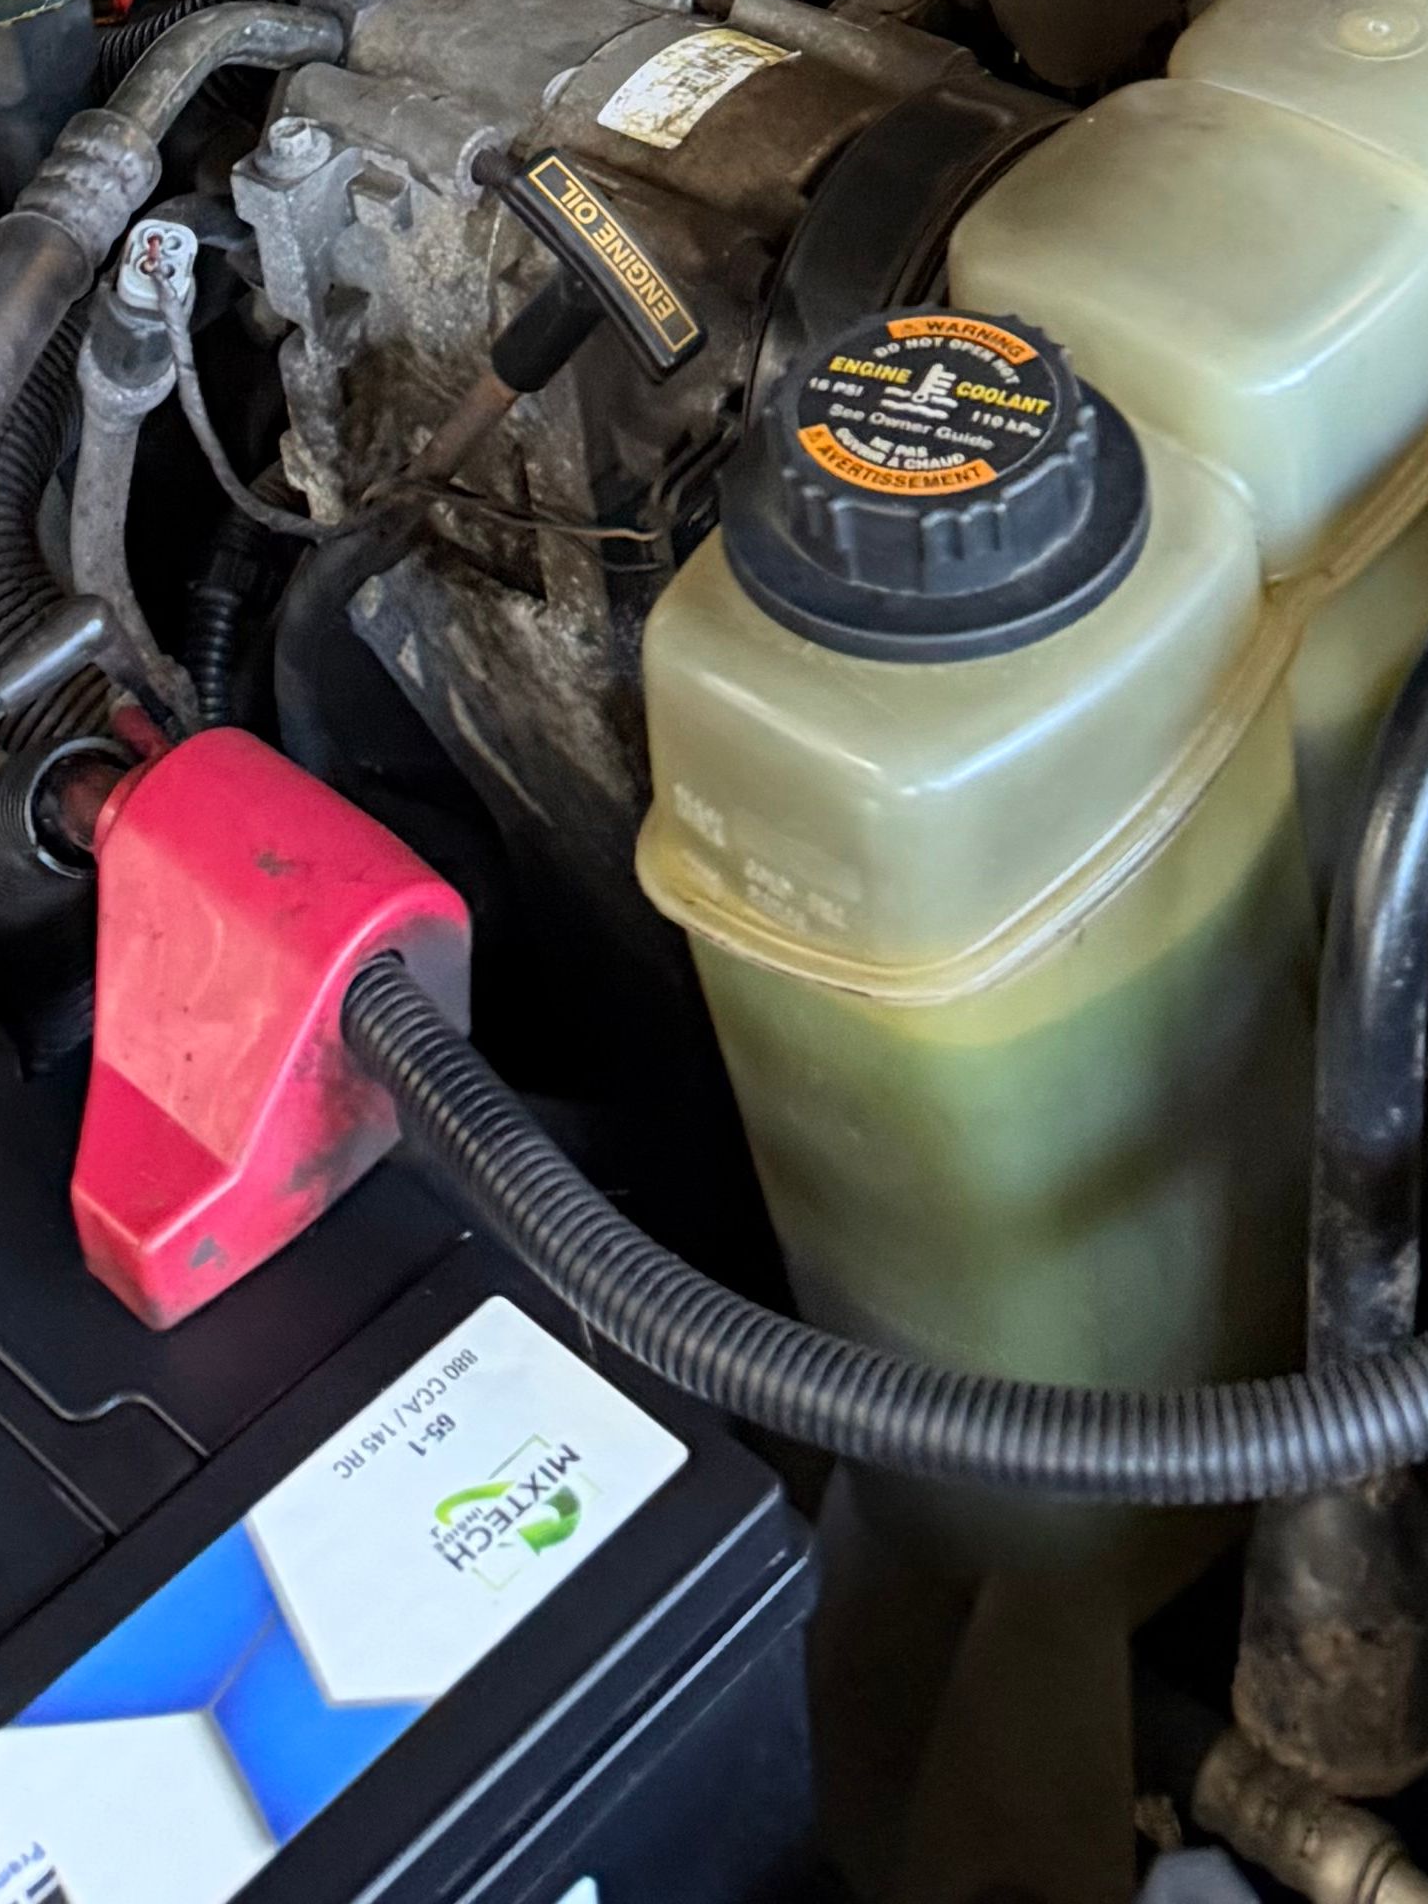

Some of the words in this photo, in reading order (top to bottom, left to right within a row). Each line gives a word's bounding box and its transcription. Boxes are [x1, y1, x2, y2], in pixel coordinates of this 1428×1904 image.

[559, 179, 601, 226] OIL
[593, 223, 676, 323] ENGINE
[873, 342, 900, 359] DO
[905, 337, 943, 350] NOT
[948, 339, 996, 362] OPEN
[925, 320, 1027, 358] WARNING
[828, 356, 913, 384] ENGINE
[955, 381, 1051, 415] COOLANT
[828, 403, 865, 421] See
[868, 411, 933, 435] Owner
[933, 426, 996, 451] Guide
[832, 380, 864, 397] PSI
[971, 410, 1002, 428] 110
[1003, 419, 1044, 439] kPa
[818, 445, 981, 489] AVERTISSEMENT
[870, 436, 895, 453] NE
[895, 443, 929, 458] PAS
[903, 452, 967, 471] CHAUD
[442, 1347, 479, 1382] 880
[405, 1376, 447, 1414] CCA
[361, 1423, 398, 1454] 145
[407, 1411, 458, 1458] 65-1
[332, 1453, 366, 1480] RC
[442, 1442, 582, 1572] MIXTECH
[433, 1507, 485, 1553] INSIDE
